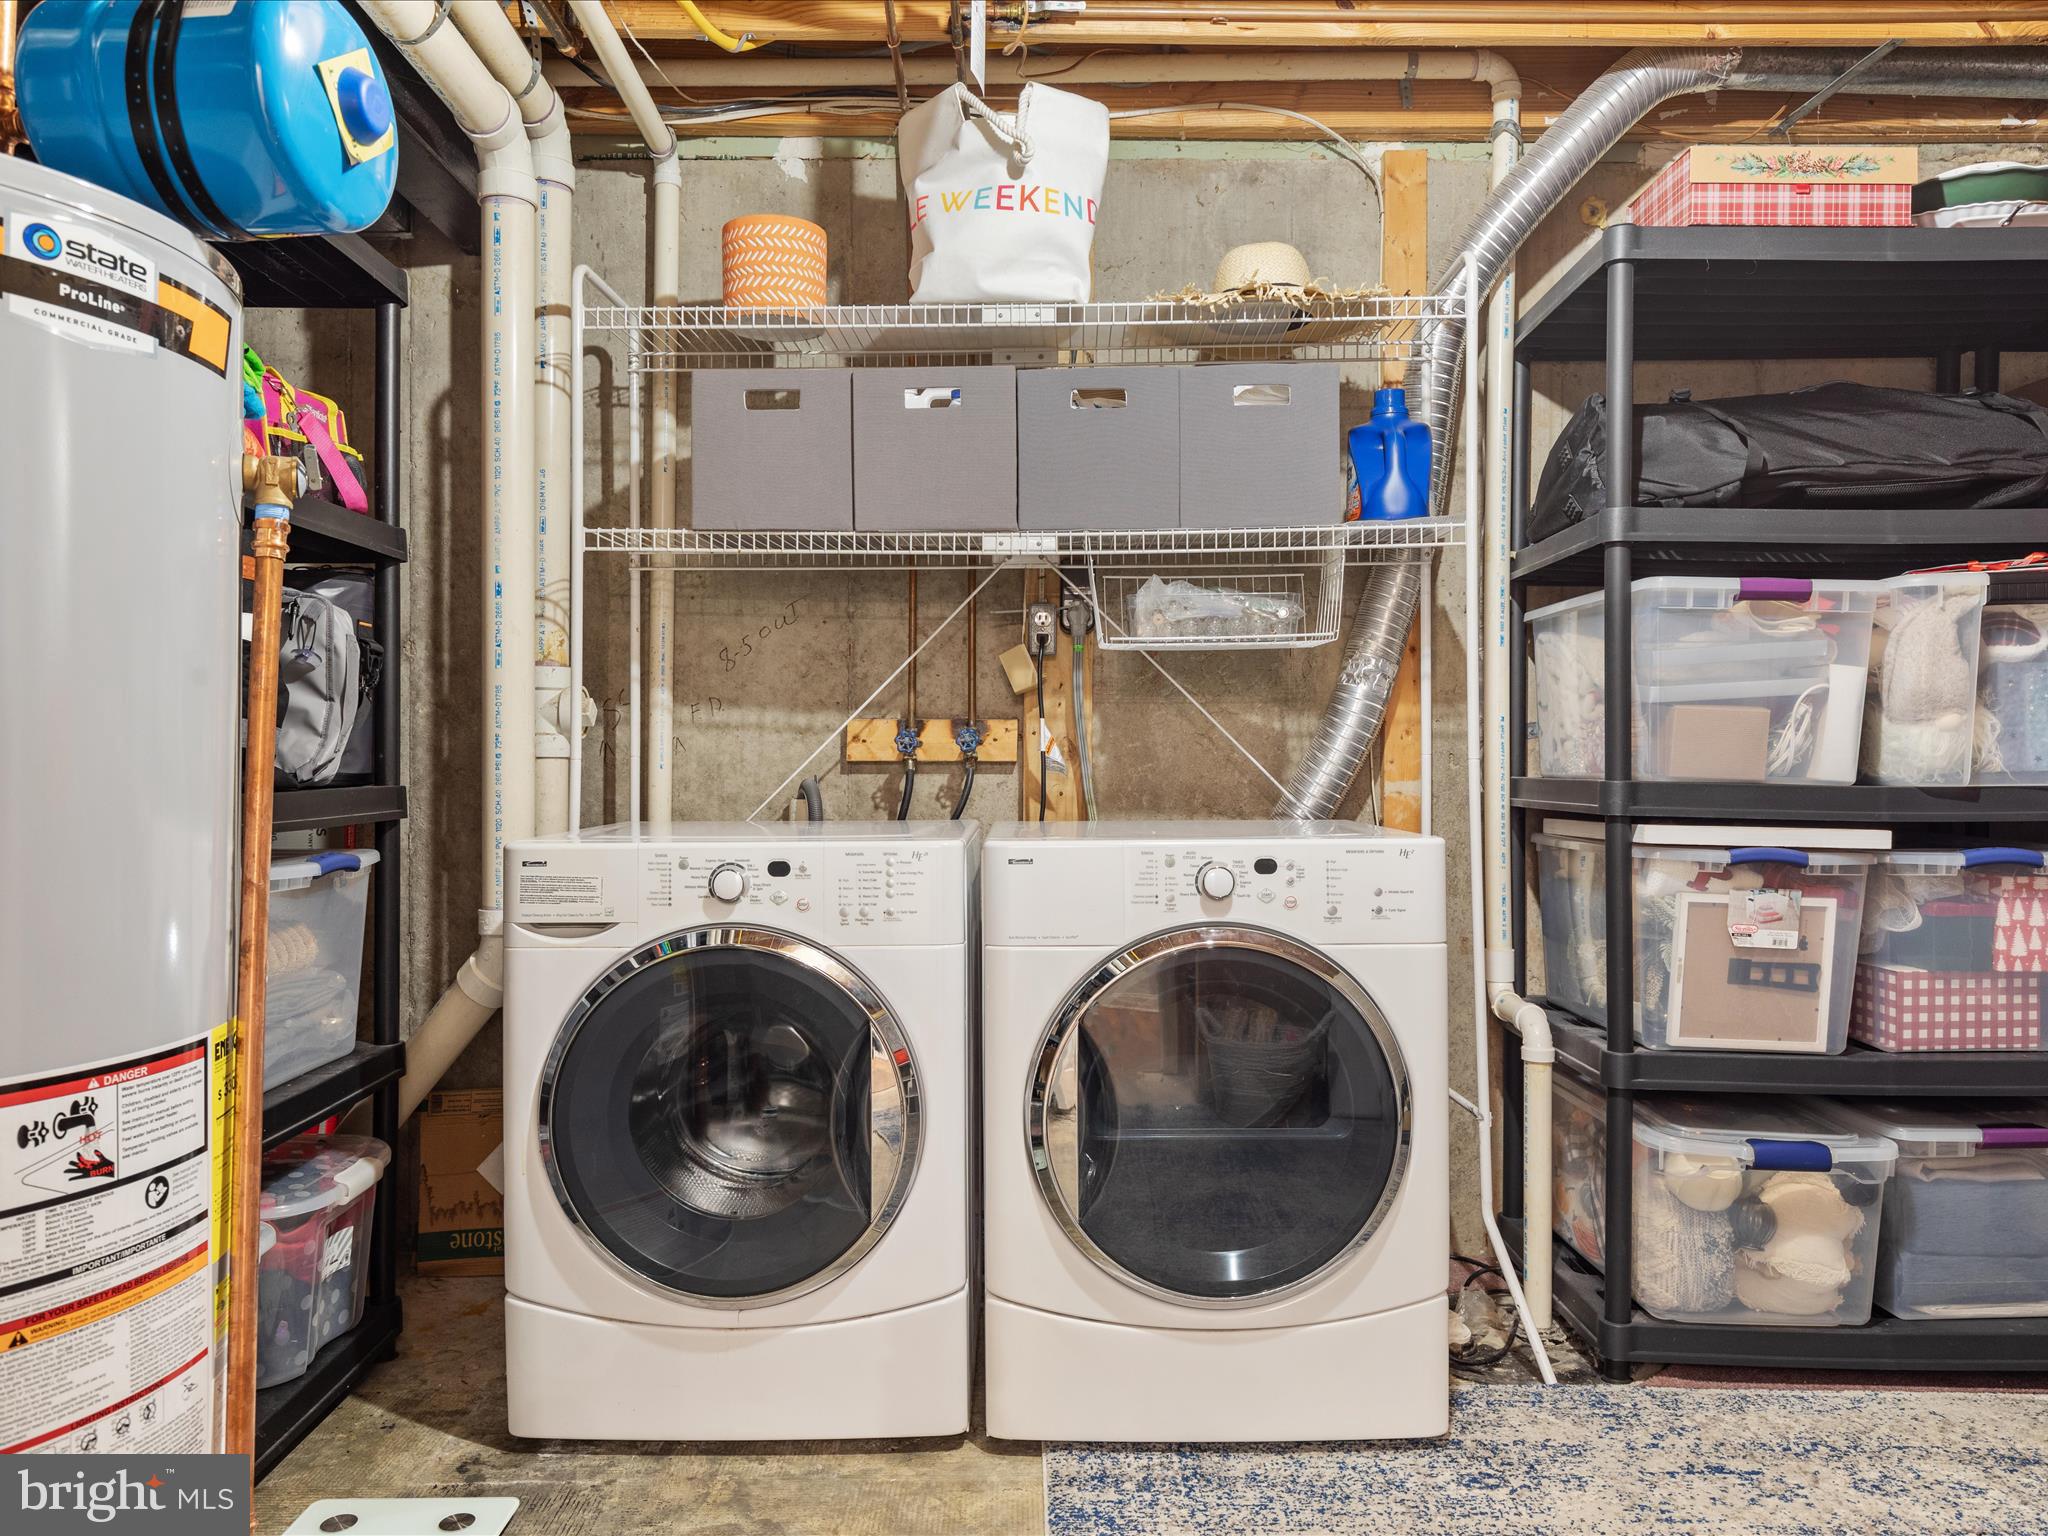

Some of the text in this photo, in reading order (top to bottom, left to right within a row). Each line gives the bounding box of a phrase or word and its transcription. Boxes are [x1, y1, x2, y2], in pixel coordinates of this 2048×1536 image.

[940, 184, 1098, 226] WEEKEND
[65, 239, 147, 284] state
[65, 257, 147, 293] WATER HEATERS
[33, 308, 138, 345] COMMERCIAL GRADE
[103, 1067, 148, 1086] DANGER
[90, 1164, 114, 1178] BURN
[25, 1313, 46, 1326] FOR
[48, 1303, 76, 1318] YOUR
[77, 1291, 111, 1310] SAFETY
[112, 1281, 133, 1299] READ
[70, 1408, 111, 1431] LIGHTING
